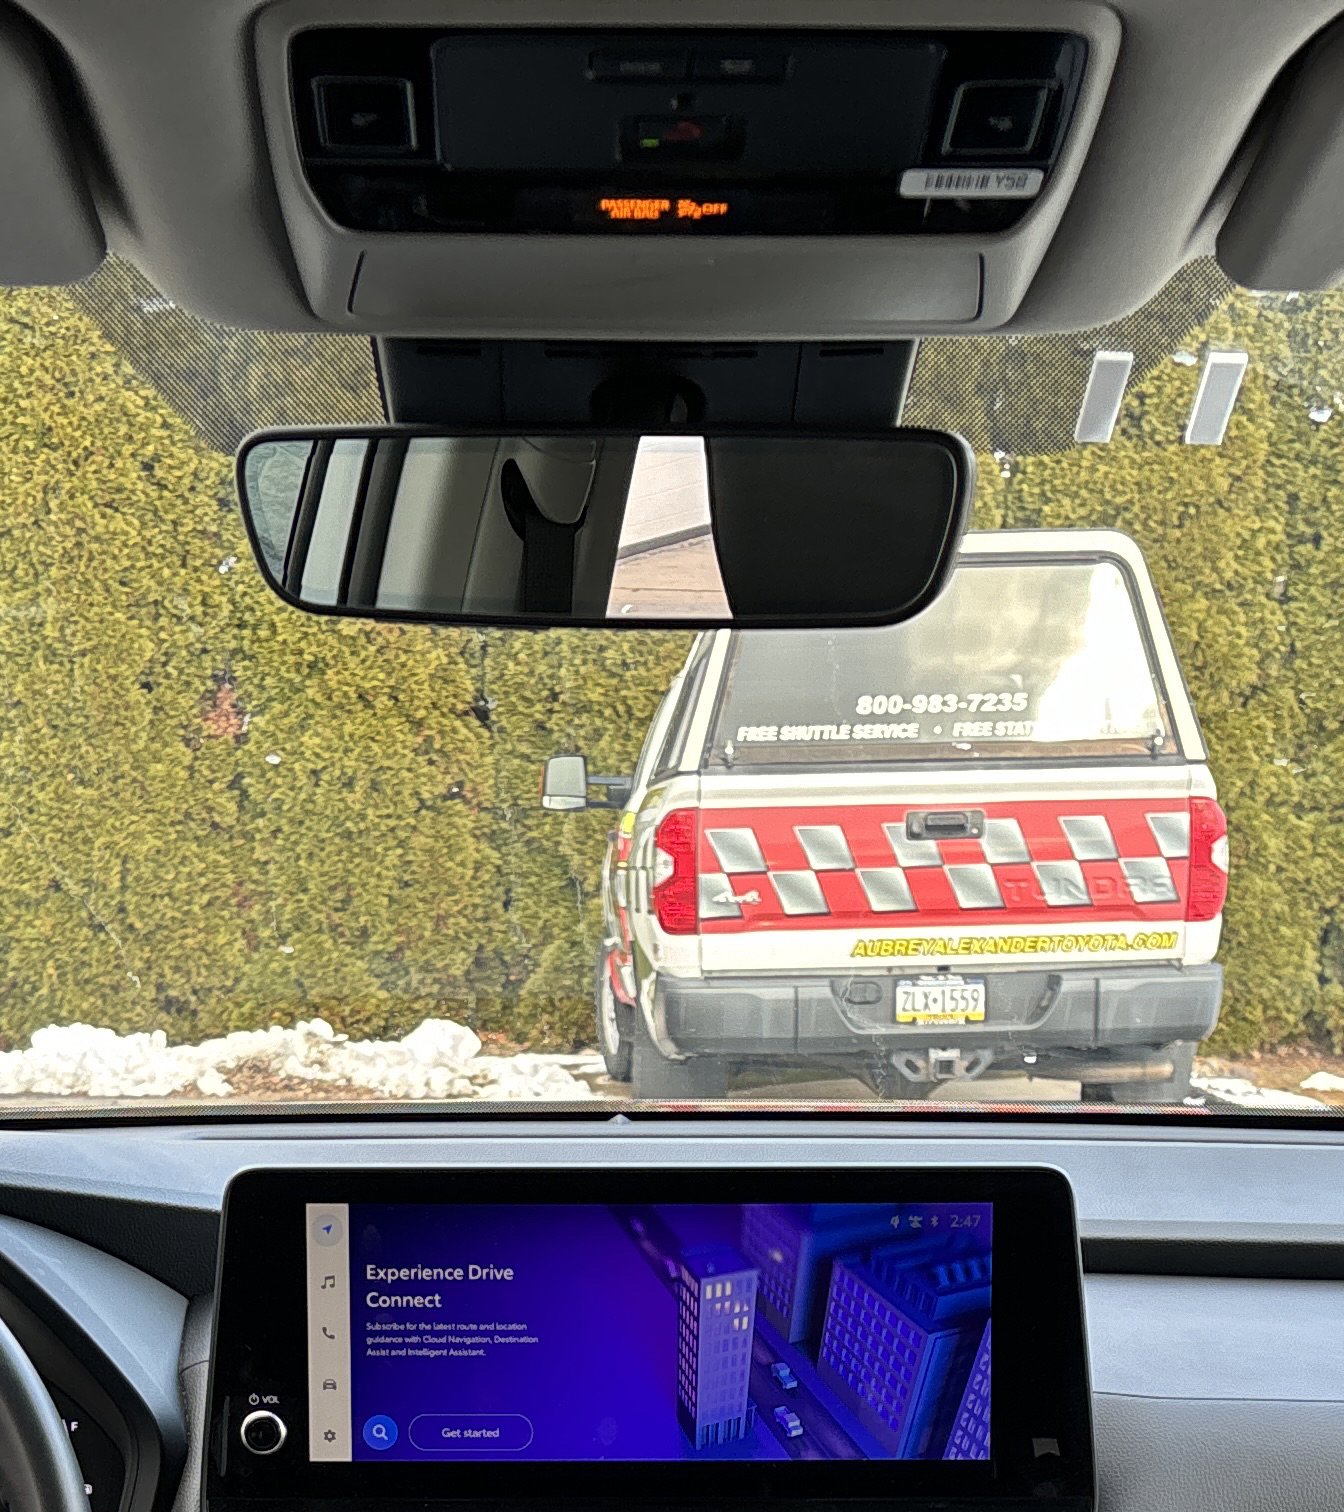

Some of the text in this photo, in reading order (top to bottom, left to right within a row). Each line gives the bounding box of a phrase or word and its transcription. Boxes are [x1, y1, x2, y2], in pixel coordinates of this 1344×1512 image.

[702, 202, 729, 215] OFF
[856, 692, 1029, 715] 800-983-7235
[736, 725, 779, 742] FREE
[779, 724, 851, 740] SHUTTLE
[852, 722, 920, 739] SERVICE
[952, 721, 993, 737] FREE
[850, 931, 1178, 958] AUBREYALEXANDERTOYOTA.COM
[949, 1214, 982, 1229] 2:47
[365, 1263, 515, 1284] Experience Drive
[365, 1291, 443, 1308] Connect
[365, 1321, 528, 1331] Subscribe for the latest route and location
[365, 1335, 539, 1345] guidance with Cloud Navigation, Destination
[365, 1348, 487, 1358] Assist and Intelligent Assistant.
[70, 1421, 79, 1432] F
[441, 1427, 500, 1438] Get started
